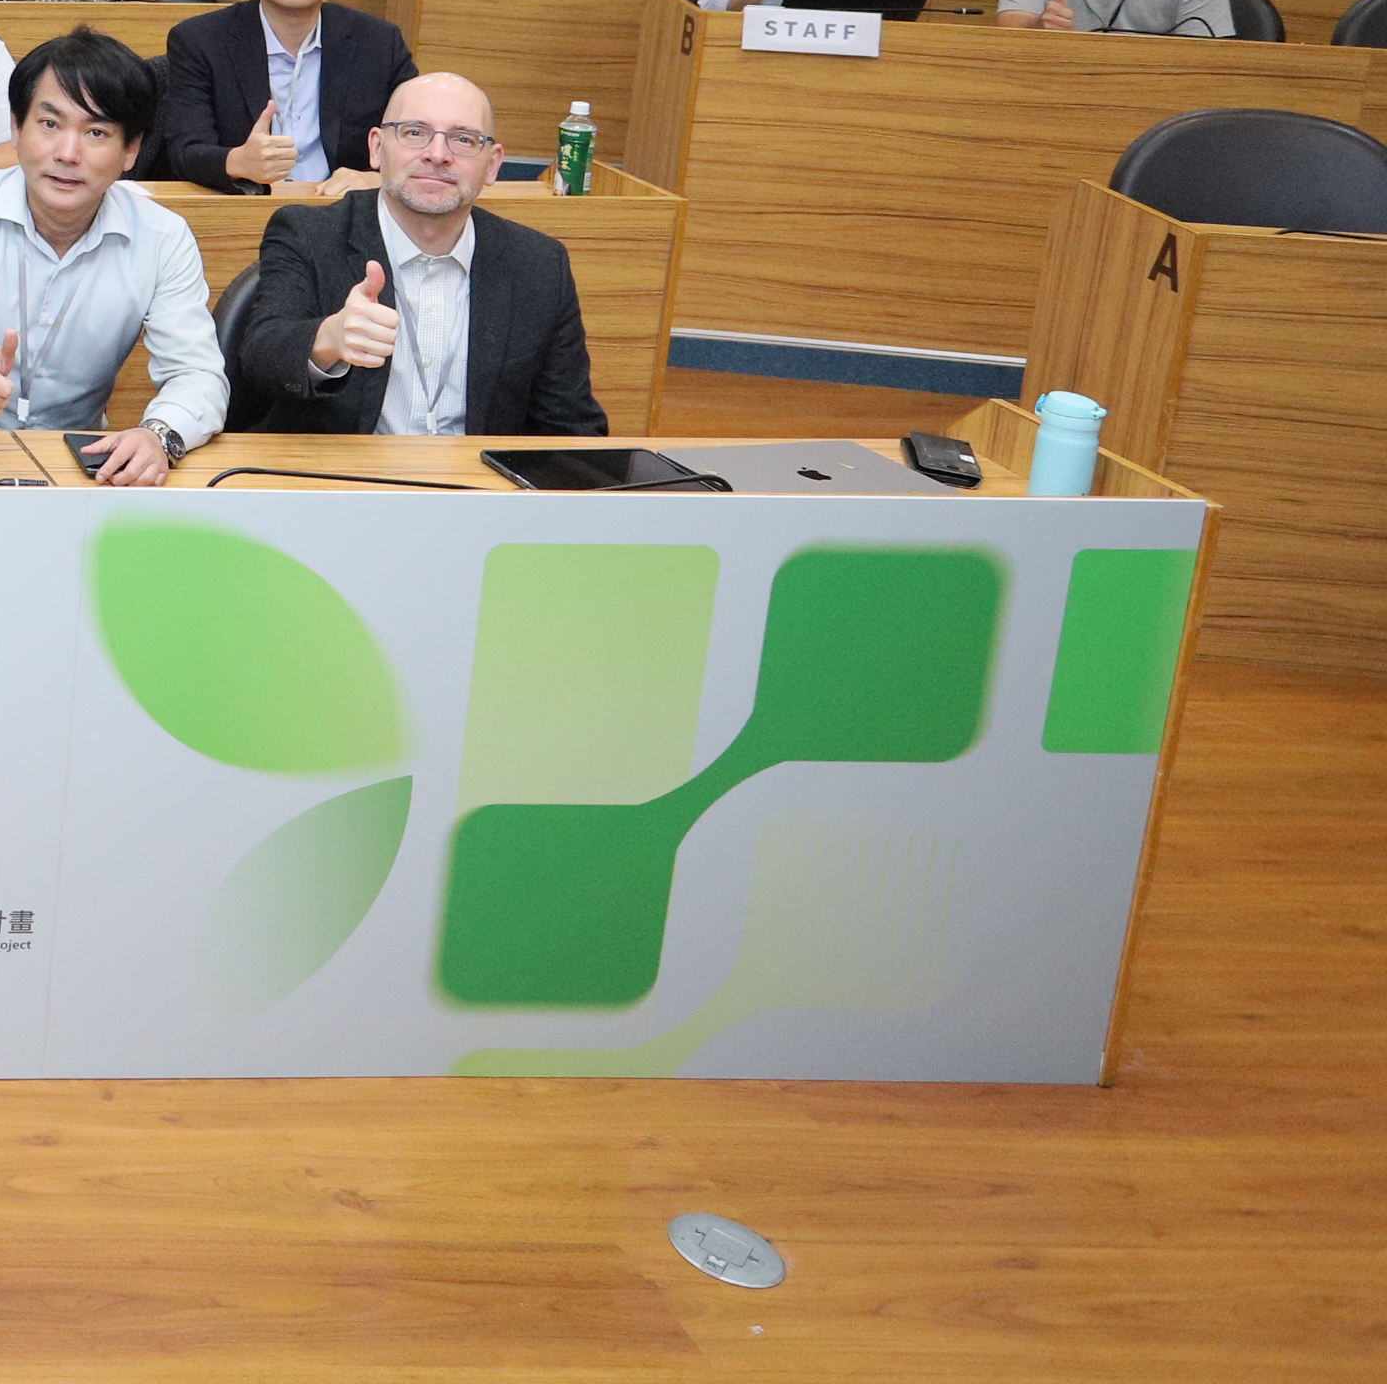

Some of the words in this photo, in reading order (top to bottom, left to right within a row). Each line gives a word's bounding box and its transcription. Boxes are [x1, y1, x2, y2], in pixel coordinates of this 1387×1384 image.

[681, 13, 695, 55] B
[764, 20, 856, 40] STAFF
[1148, 232, 1178, 293] A
